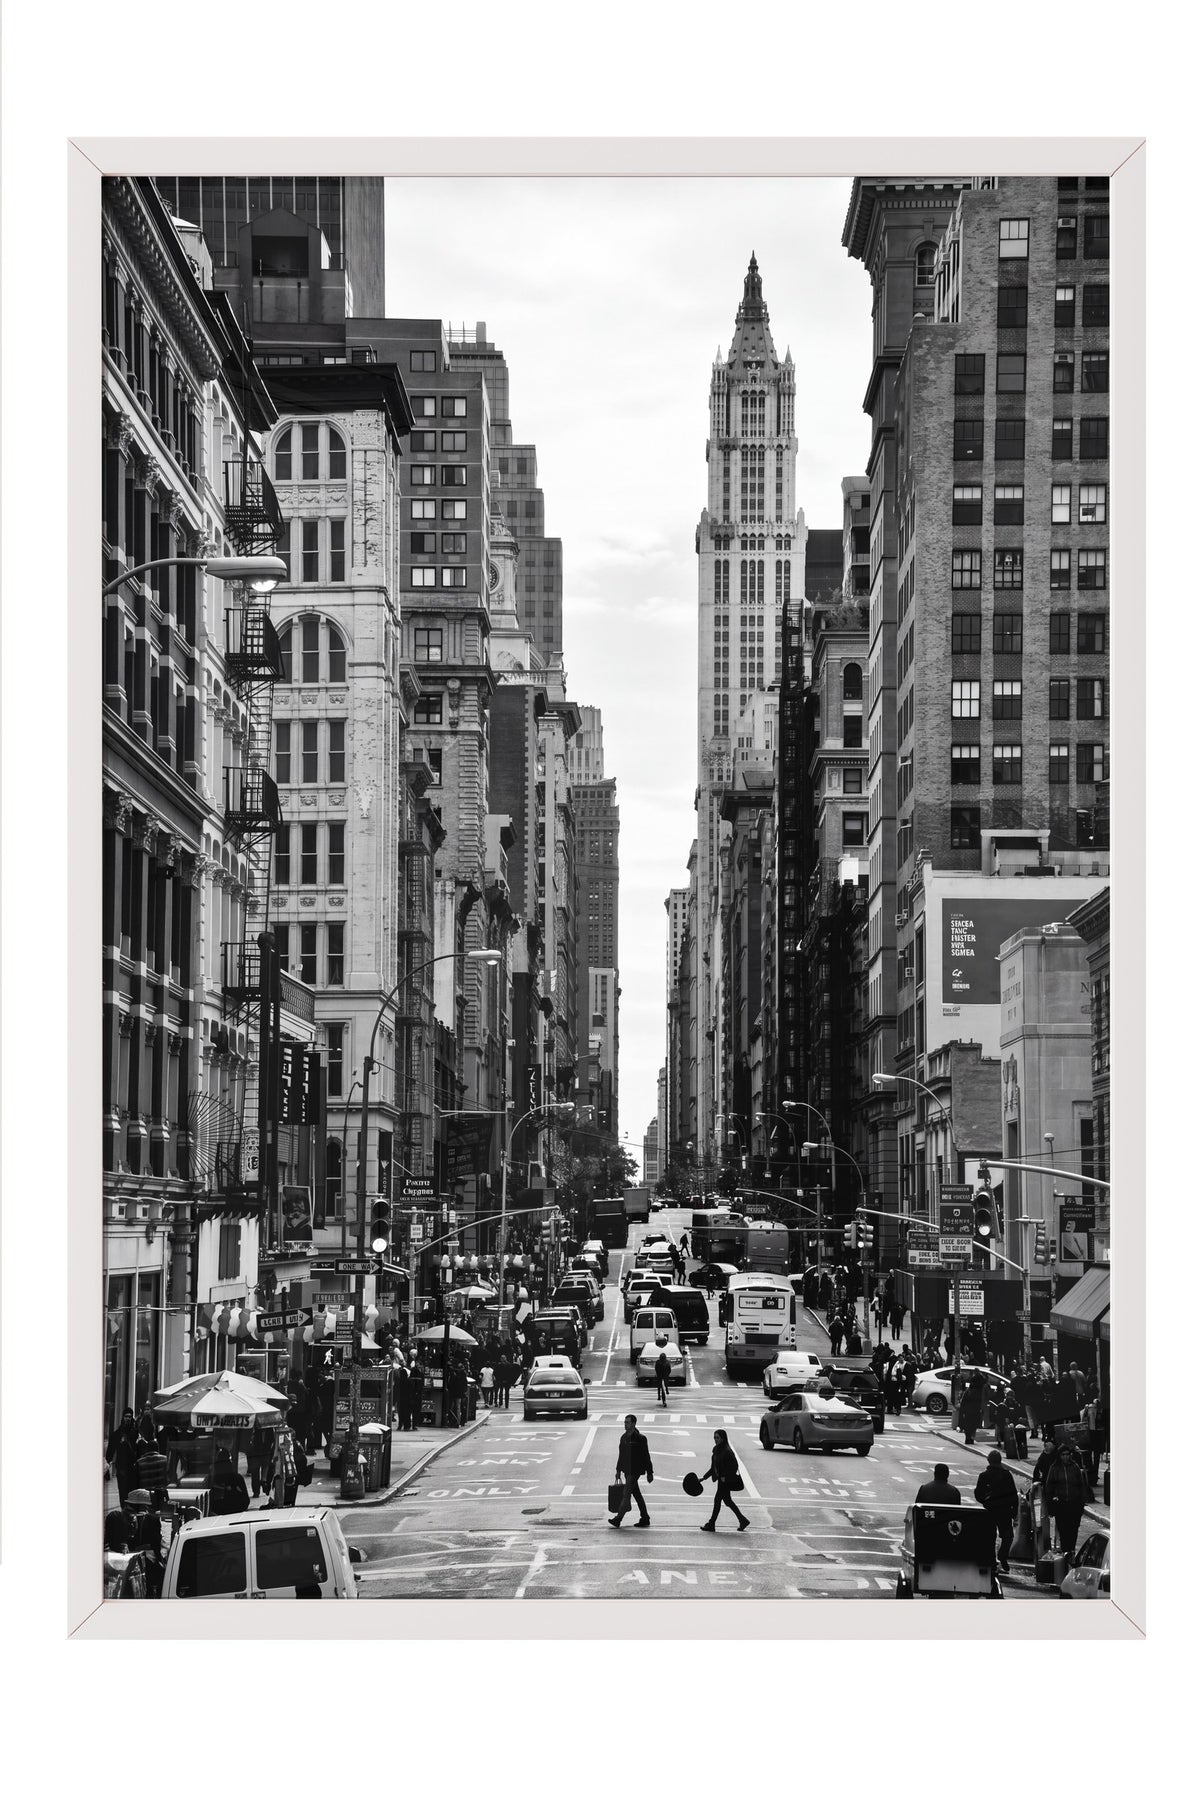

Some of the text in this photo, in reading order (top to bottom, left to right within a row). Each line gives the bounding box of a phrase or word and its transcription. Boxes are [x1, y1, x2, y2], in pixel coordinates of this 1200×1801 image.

[342, 1263, 376, 1271] ONE WAY
[456, 1457, 552, 1467] ONLY
[777, 1476, 873, 1487] ONLY
[426, 1485, 540, 1498] ONLY
[788, 1487, 878, 1498] BUS
